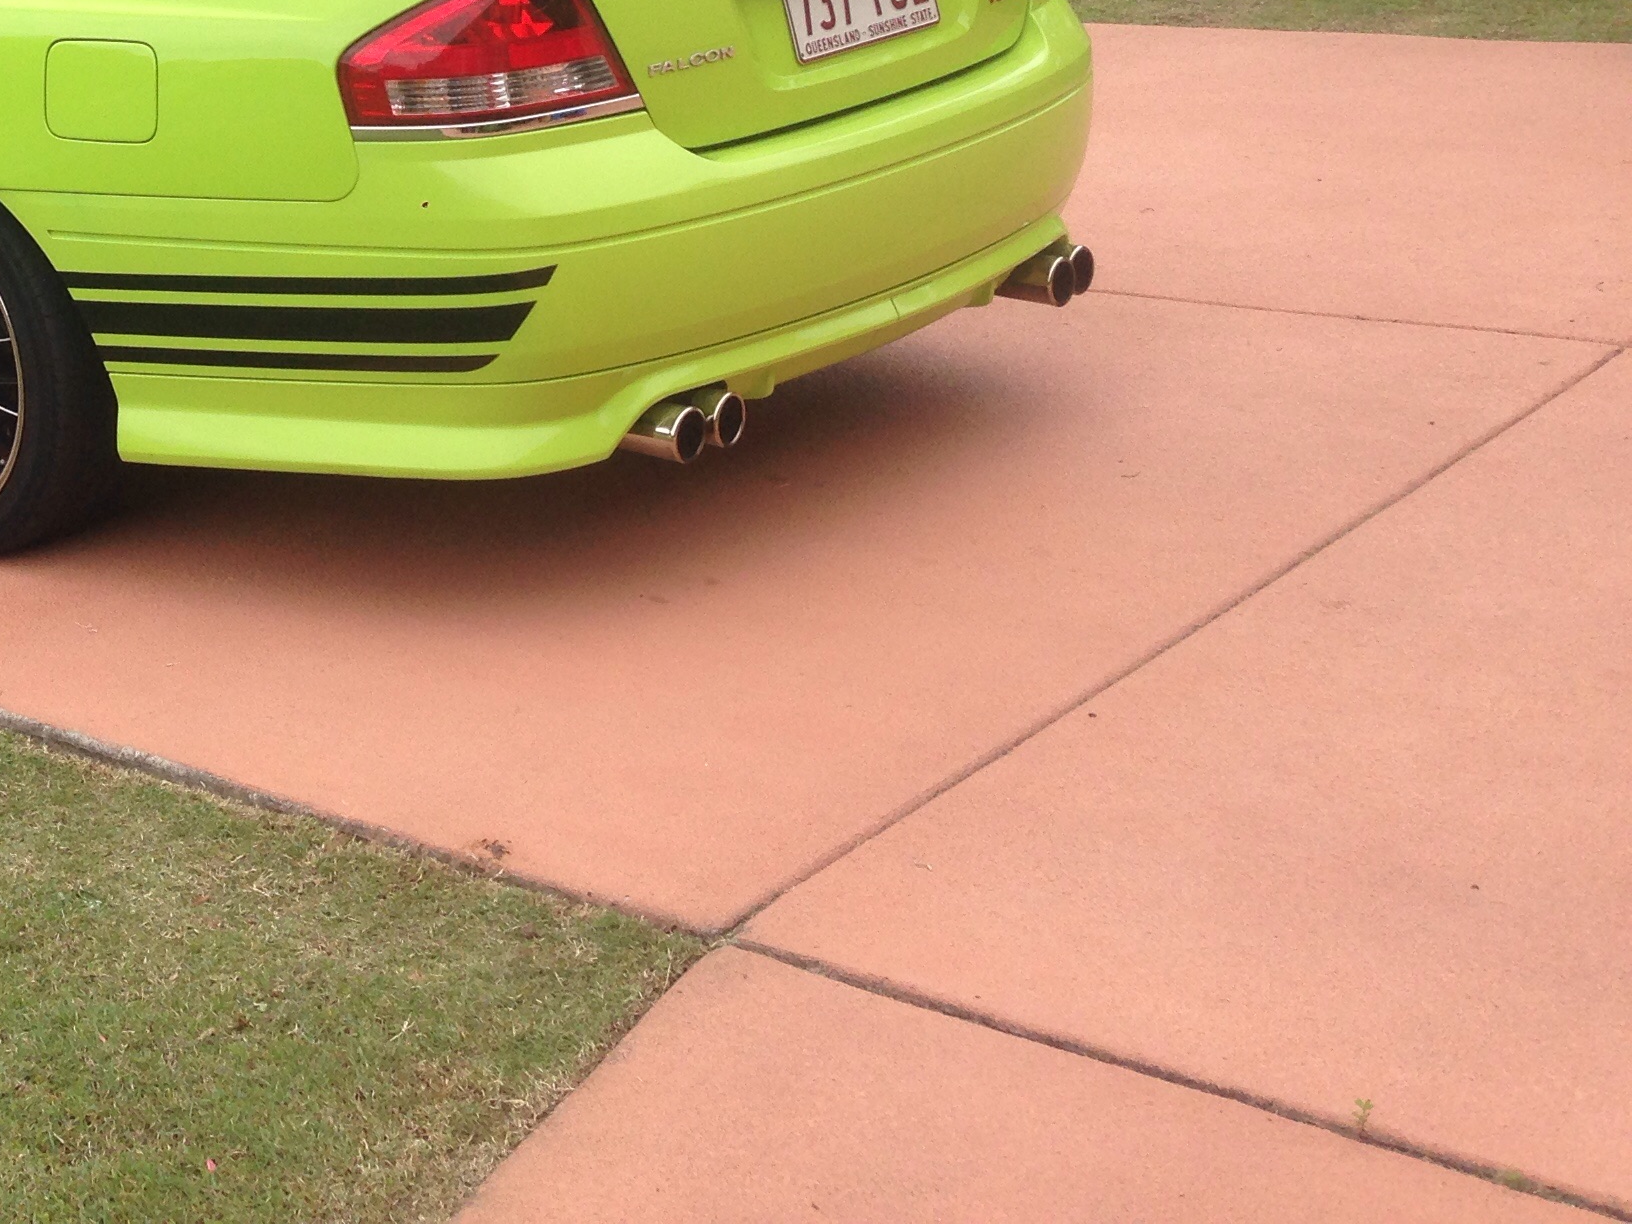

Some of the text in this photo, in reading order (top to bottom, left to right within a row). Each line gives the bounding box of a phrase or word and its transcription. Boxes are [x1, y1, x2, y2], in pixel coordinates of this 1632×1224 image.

[805, 28, 861, 55] QUEENSLAND
[868, 14, 909, 37] SUNSHINE
[647, 45, 735, 78] FALCON
